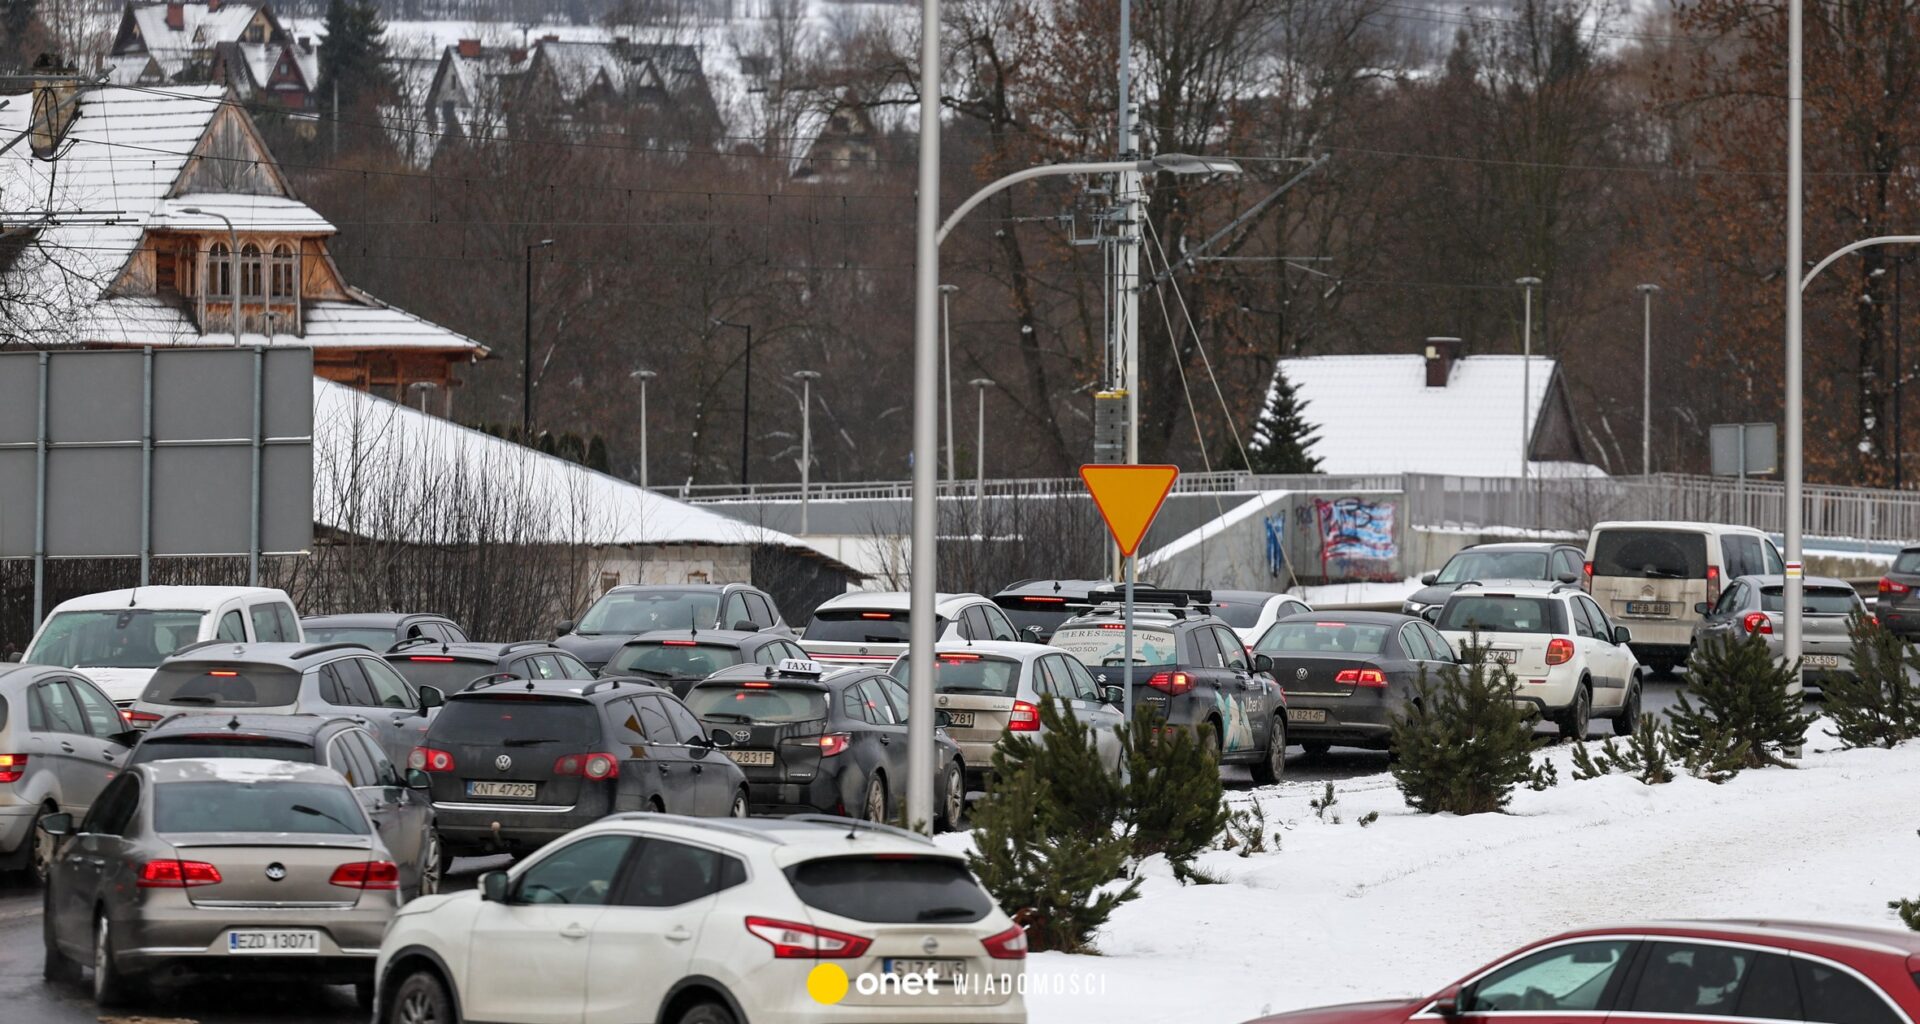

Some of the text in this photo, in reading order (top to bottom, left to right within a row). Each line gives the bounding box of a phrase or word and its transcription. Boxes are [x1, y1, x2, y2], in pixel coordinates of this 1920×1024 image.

[1142, 633, 1166, 643] Uber
[786, 661, 812, 671] TAXI
[737, 752, 772, 763] 2831F
[474, 783, 534, 796] KNT 47295
[238, 934, 314, 948] EZD 13071
